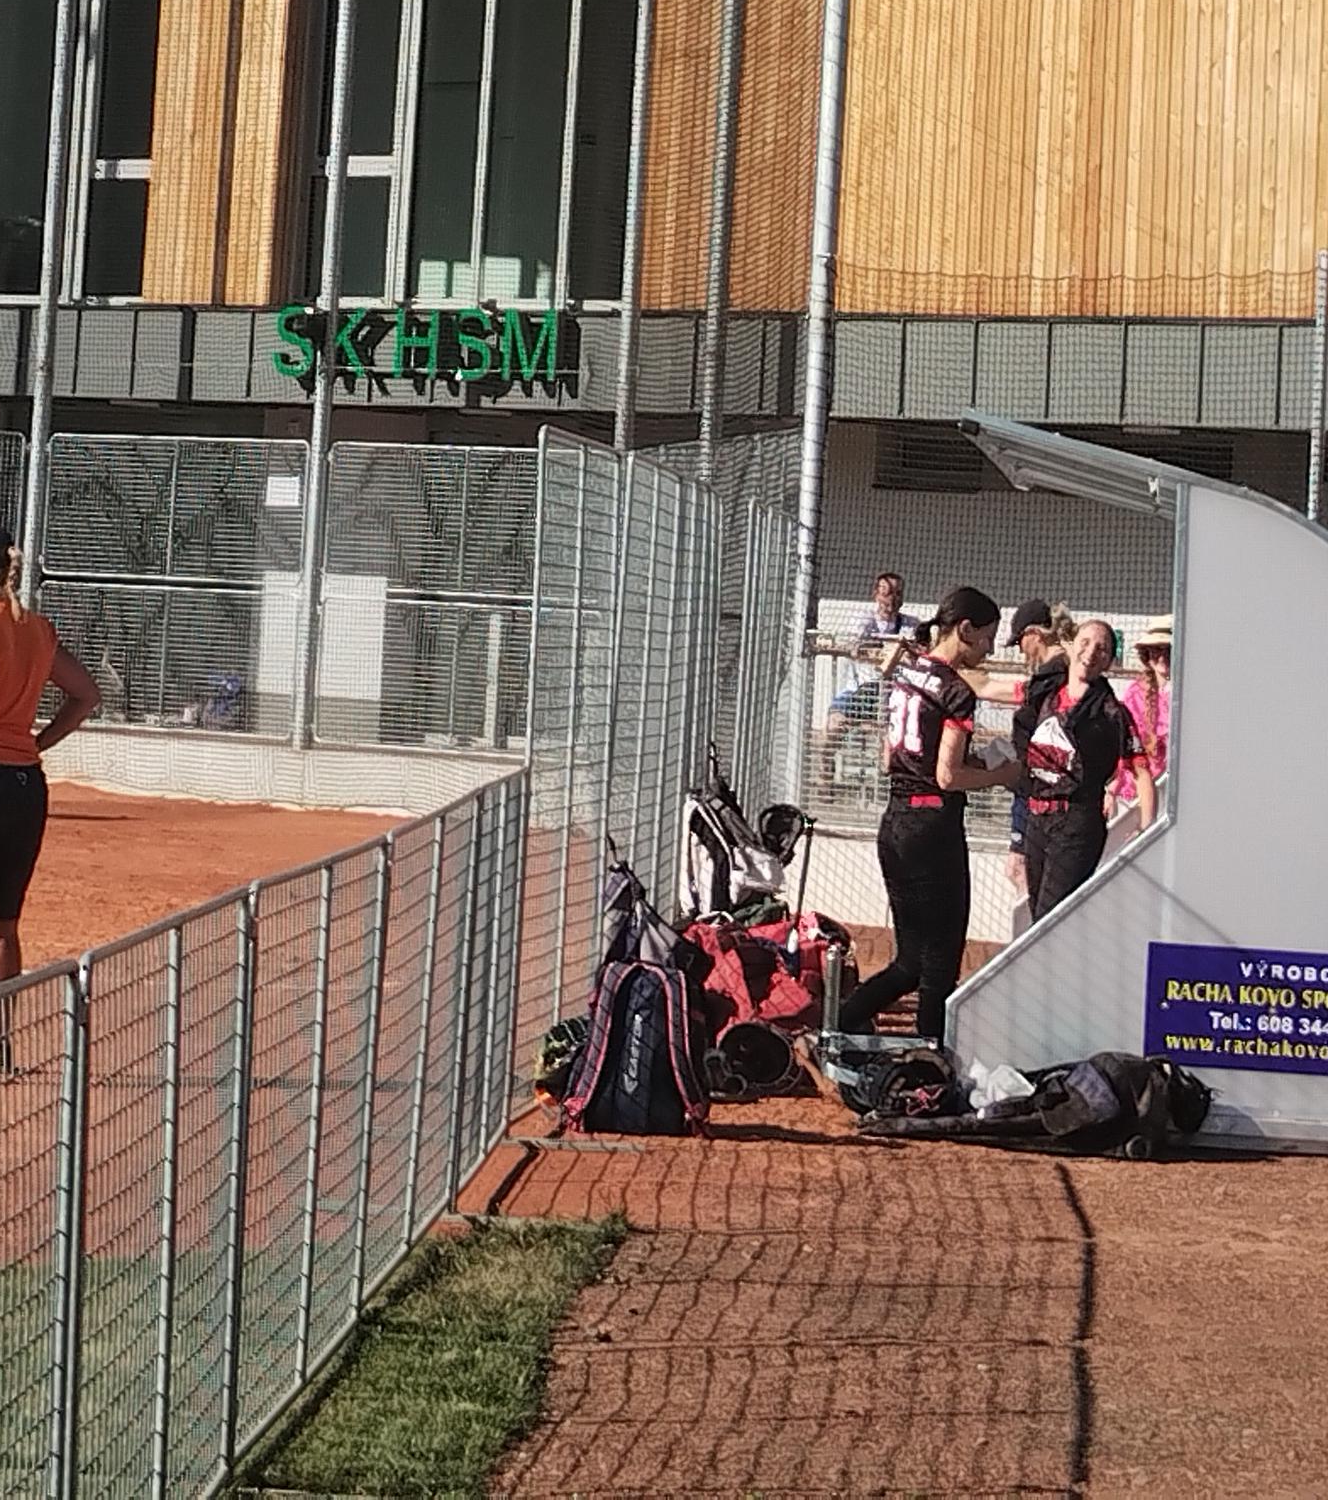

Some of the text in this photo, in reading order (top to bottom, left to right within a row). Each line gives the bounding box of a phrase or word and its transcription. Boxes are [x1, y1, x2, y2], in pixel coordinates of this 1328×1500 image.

[1166, 980, 1233, 1004] RACHA
[1238, 985, 1296, 1008] KOVO
[1208, 1010, 1252, 1031] Tel.:
[1257, 1014, 1294, 1034] 608
